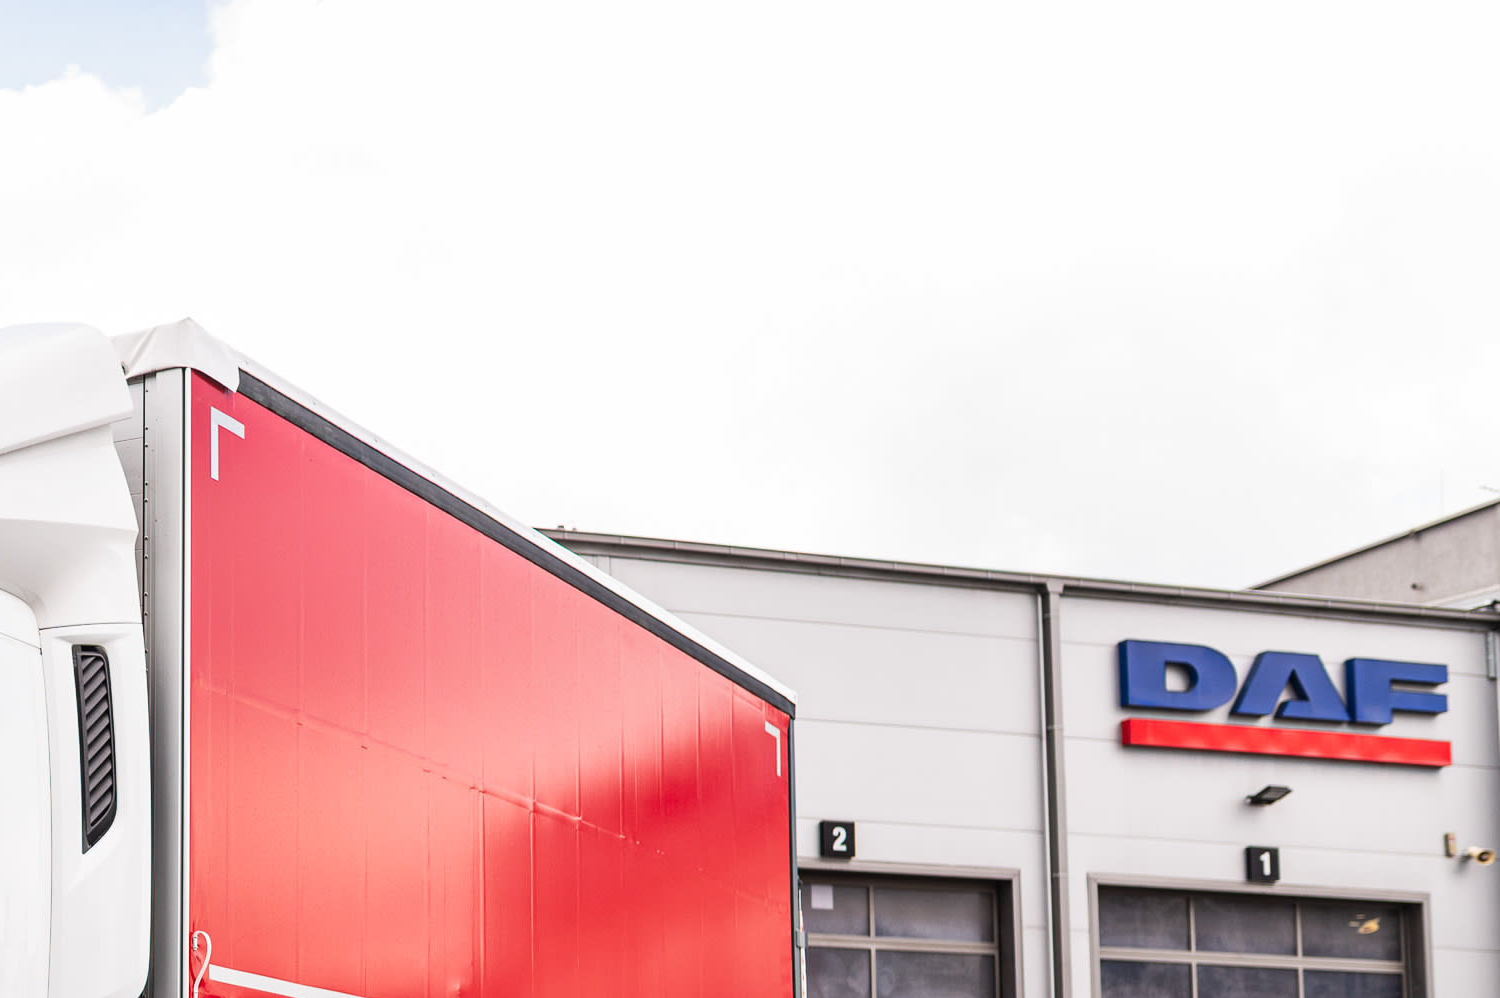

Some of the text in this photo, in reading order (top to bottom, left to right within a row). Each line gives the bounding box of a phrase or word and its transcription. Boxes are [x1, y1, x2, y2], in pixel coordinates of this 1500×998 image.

[1117, 639, 1449, 727] DAF
[832, 826, 848, 852] 2
[1260, 851, 1271, 876] 1
